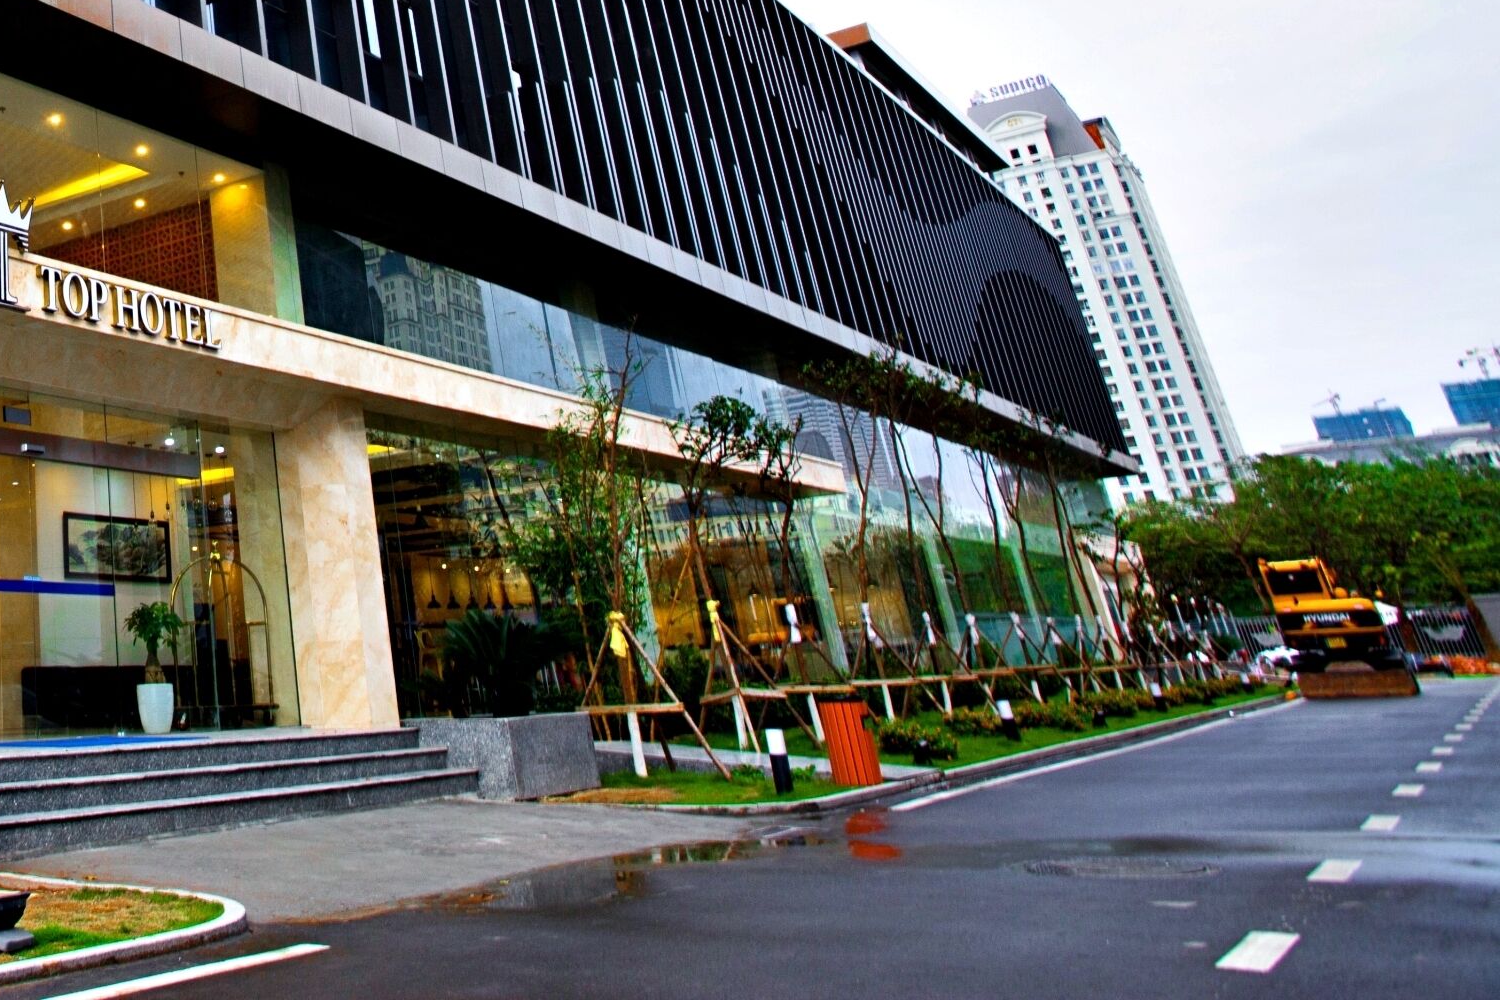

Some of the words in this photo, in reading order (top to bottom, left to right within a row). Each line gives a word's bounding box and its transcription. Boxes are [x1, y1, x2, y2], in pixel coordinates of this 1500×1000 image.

[38, 265, 109, 322] TOP
[113, 285, 223, 351] HOTEL
[1303, 612, 1351, 623] HYUNDAI
